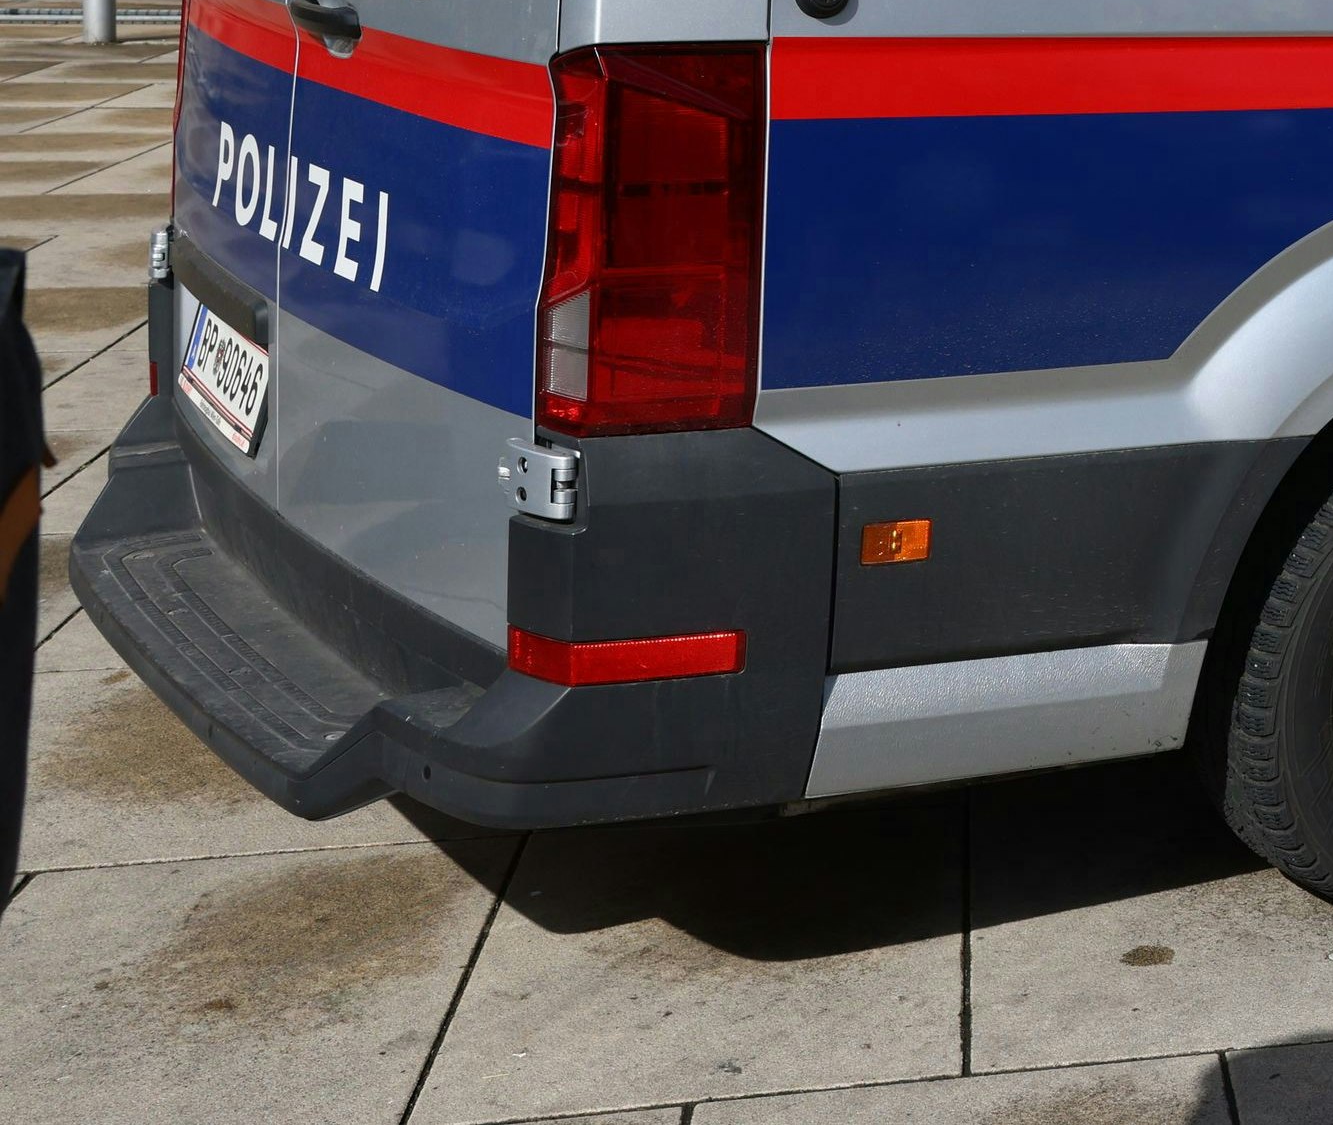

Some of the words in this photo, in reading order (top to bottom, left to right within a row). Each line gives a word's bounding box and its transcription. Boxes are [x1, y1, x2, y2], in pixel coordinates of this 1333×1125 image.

[211, 120, 390, 293] POLIZEI
[197, 317, 219, 373] BP
[216, 337, 264, 417] 90646
